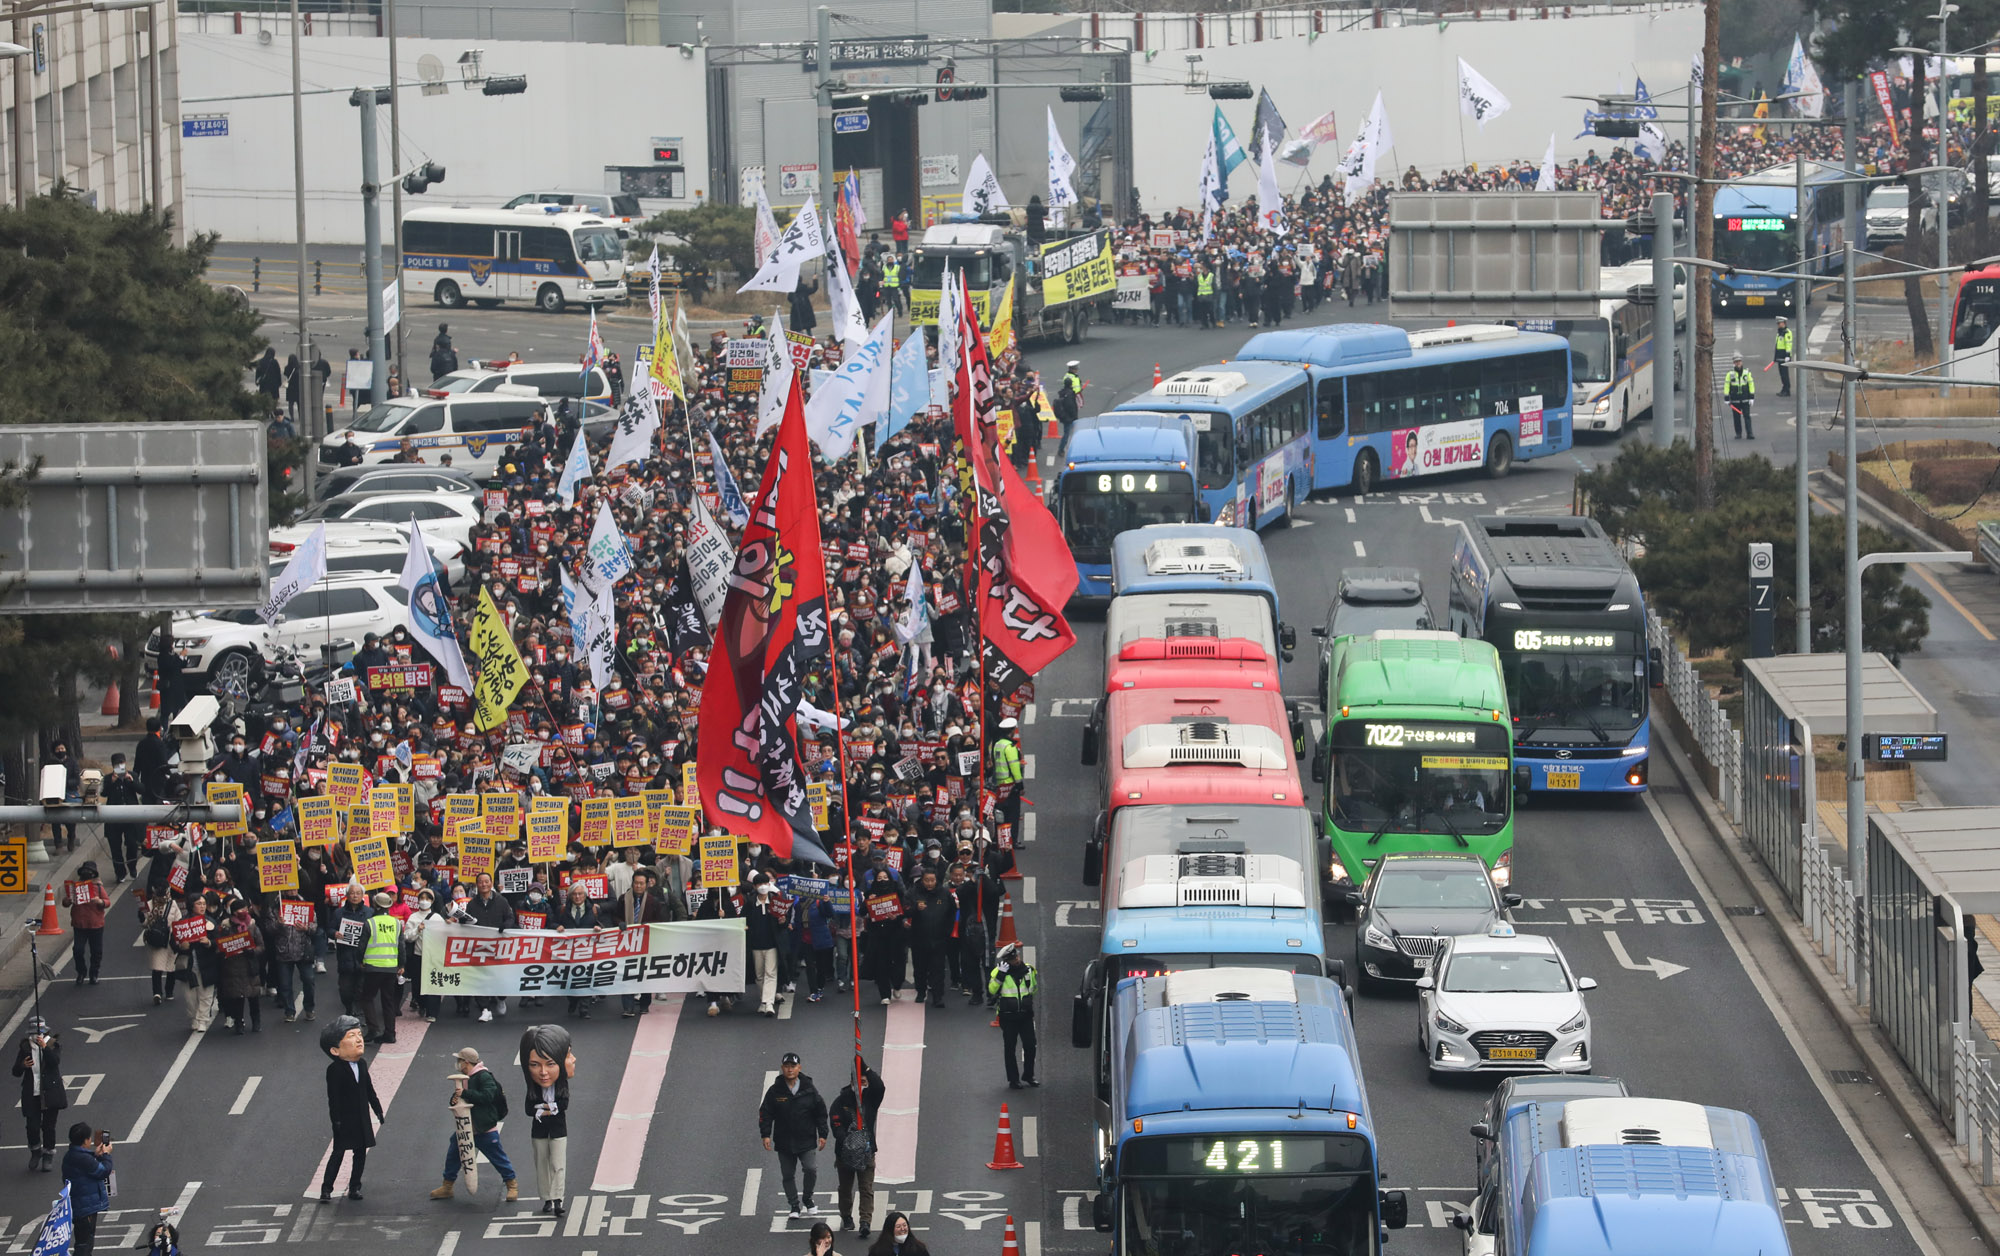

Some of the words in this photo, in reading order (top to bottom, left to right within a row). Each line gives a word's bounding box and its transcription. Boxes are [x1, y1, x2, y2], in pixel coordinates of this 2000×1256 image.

[193, 121, 228, 130] 후암로60길
[1728, 219, 1742, 231] 162
[407, 257, 433, 267] POLICE
[435, 257, 450, 268] 경찰
[1065, 266, 1090, 299] 윤석열
[1494, 400, 1509, 415] 704
[1099, 474, 1158, 492] 604
[1756, 585, 1769, 606] 7
[1514, 631, 1542, 650] 605
[1585, 635, 1614, 647] 후암동
[370, 670, 428, 689] 윤석열퇴진
[1365, 724, 1404, 747] 7022
[1404, 730, 1435, 743] 구산동
[1446, 730, 1476, 744] 서울역
[328, 784, 357, 796] 윤석열
[302, 800, 330, 810] 민주파괴
[488, 805, 515, 813] 독재정권
[614, 800, 642, 810] 민주파괴
[305, 808, 332, 818] 검찰독재
[372, 810, 396, 821] 윤석열
[617, 809, 644, 818] 검찰독재
[665, 809, 690, 818] 정치검찰
[303, 817, 332, 830] 윤석열
[485, 815, 514, 825] 윤석열
[531, 816, 558, 825] 정치검찰
[583, 819, 608, 830] 윤석열
[616, 818, 644, 830] 윤석열
[665, 818, 690, 827] 독재정권
[372, 821, 391, 833] 타도!
[486, 825, 509, 836] 타도!
[533, 824, 560, 832] 독재정권
[304, 829, 328, 841] 타도!
[583, 831, 602, 841] 타도!
[616, 830, 640, 842] 타도!
[660, 827, 688, 839] 윤석열
[463, 837, 490, 845] 민주파괴
[531, 834, 561, 846] 윤석열
[659, 839, 682, 850] 타도!
[704, 840, 732, 849] 정치검찰
[261, 845, 290, 855] 정치검찰
[354, 841, 381, 853] 민주파괴
[465, 846, 491, 854] 검찰독재
[532, 846, 556, 857] 타도!
[706, 848, 734, 857] 독재정권
[263, 853, 292, 862] 독재정권
[357, 849, 385, 861] 검찰독재
[461, 855, 490, 866] 윤석열
[262, 862, 292, 876] 윤석열
[357, 860, 386, 875] 윤석열
[704, 859, 733, 871] 윤석열
[263, 874, 288, 886] 타도!
[360, 873, 383, 886] 타도!
[504, 873, 529, 881] 김건희
[705, 871, 728, 882] 타도!
[504, 880, 528, 892] 특검
[284, 904, 310, 915] 윤석열
[450, 936, 544, 964] 민주파괴
[549, 927, 646, 962] 검찰독재
[519, 959, 618, 991] 윤석열을
[624, 951, 729, 983] 타도하자!
[1514, 1050, 1533, 1059] 1439
[1205, 1140, 1284, 1170] 421
[482, 1194, 730, 1240] 숭례문
